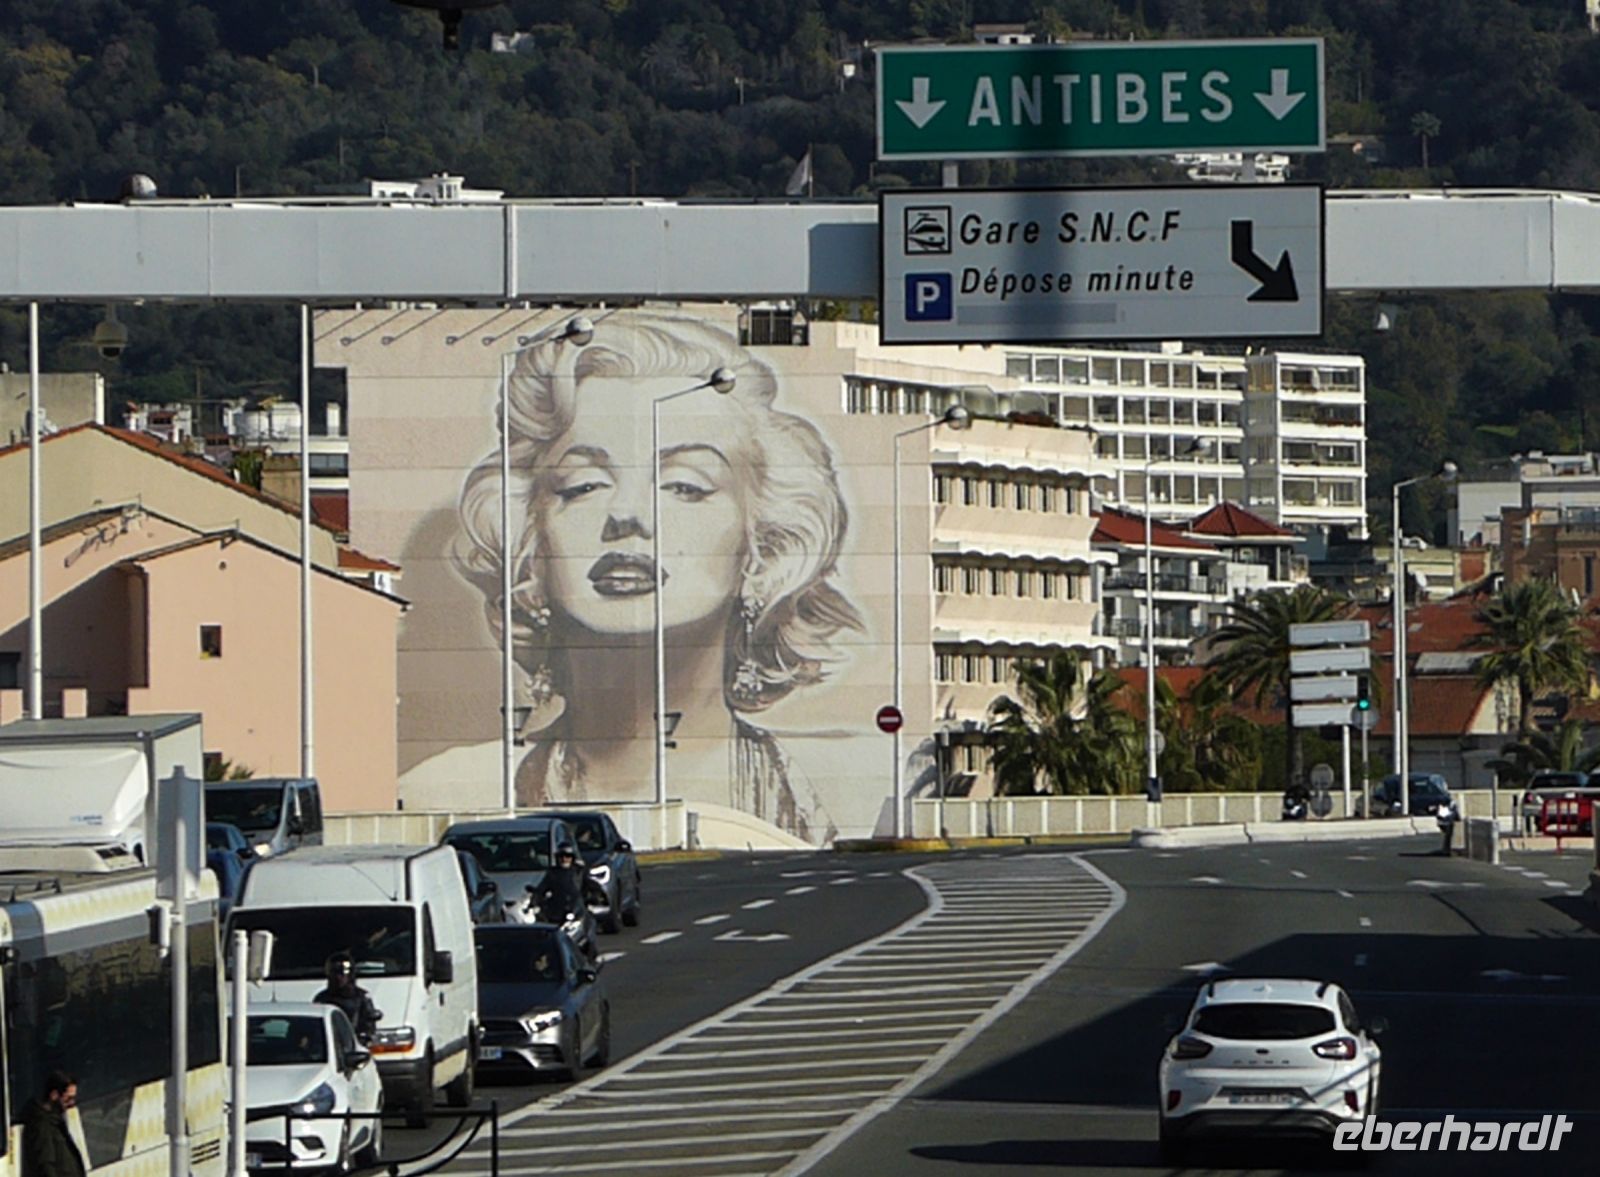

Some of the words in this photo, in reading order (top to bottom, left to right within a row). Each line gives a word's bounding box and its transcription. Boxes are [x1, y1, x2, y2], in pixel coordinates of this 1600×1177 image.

[968, 70, 1234, 127] ANTIBES
[960, 213, 1040, 245] Gare
[1057, 210, 1181, 243] S.N.C.F
[917, 281, 941, 313] P
[960, 267, 1073, 301] Dépose
[1087, 264, 1195, 292] minute
